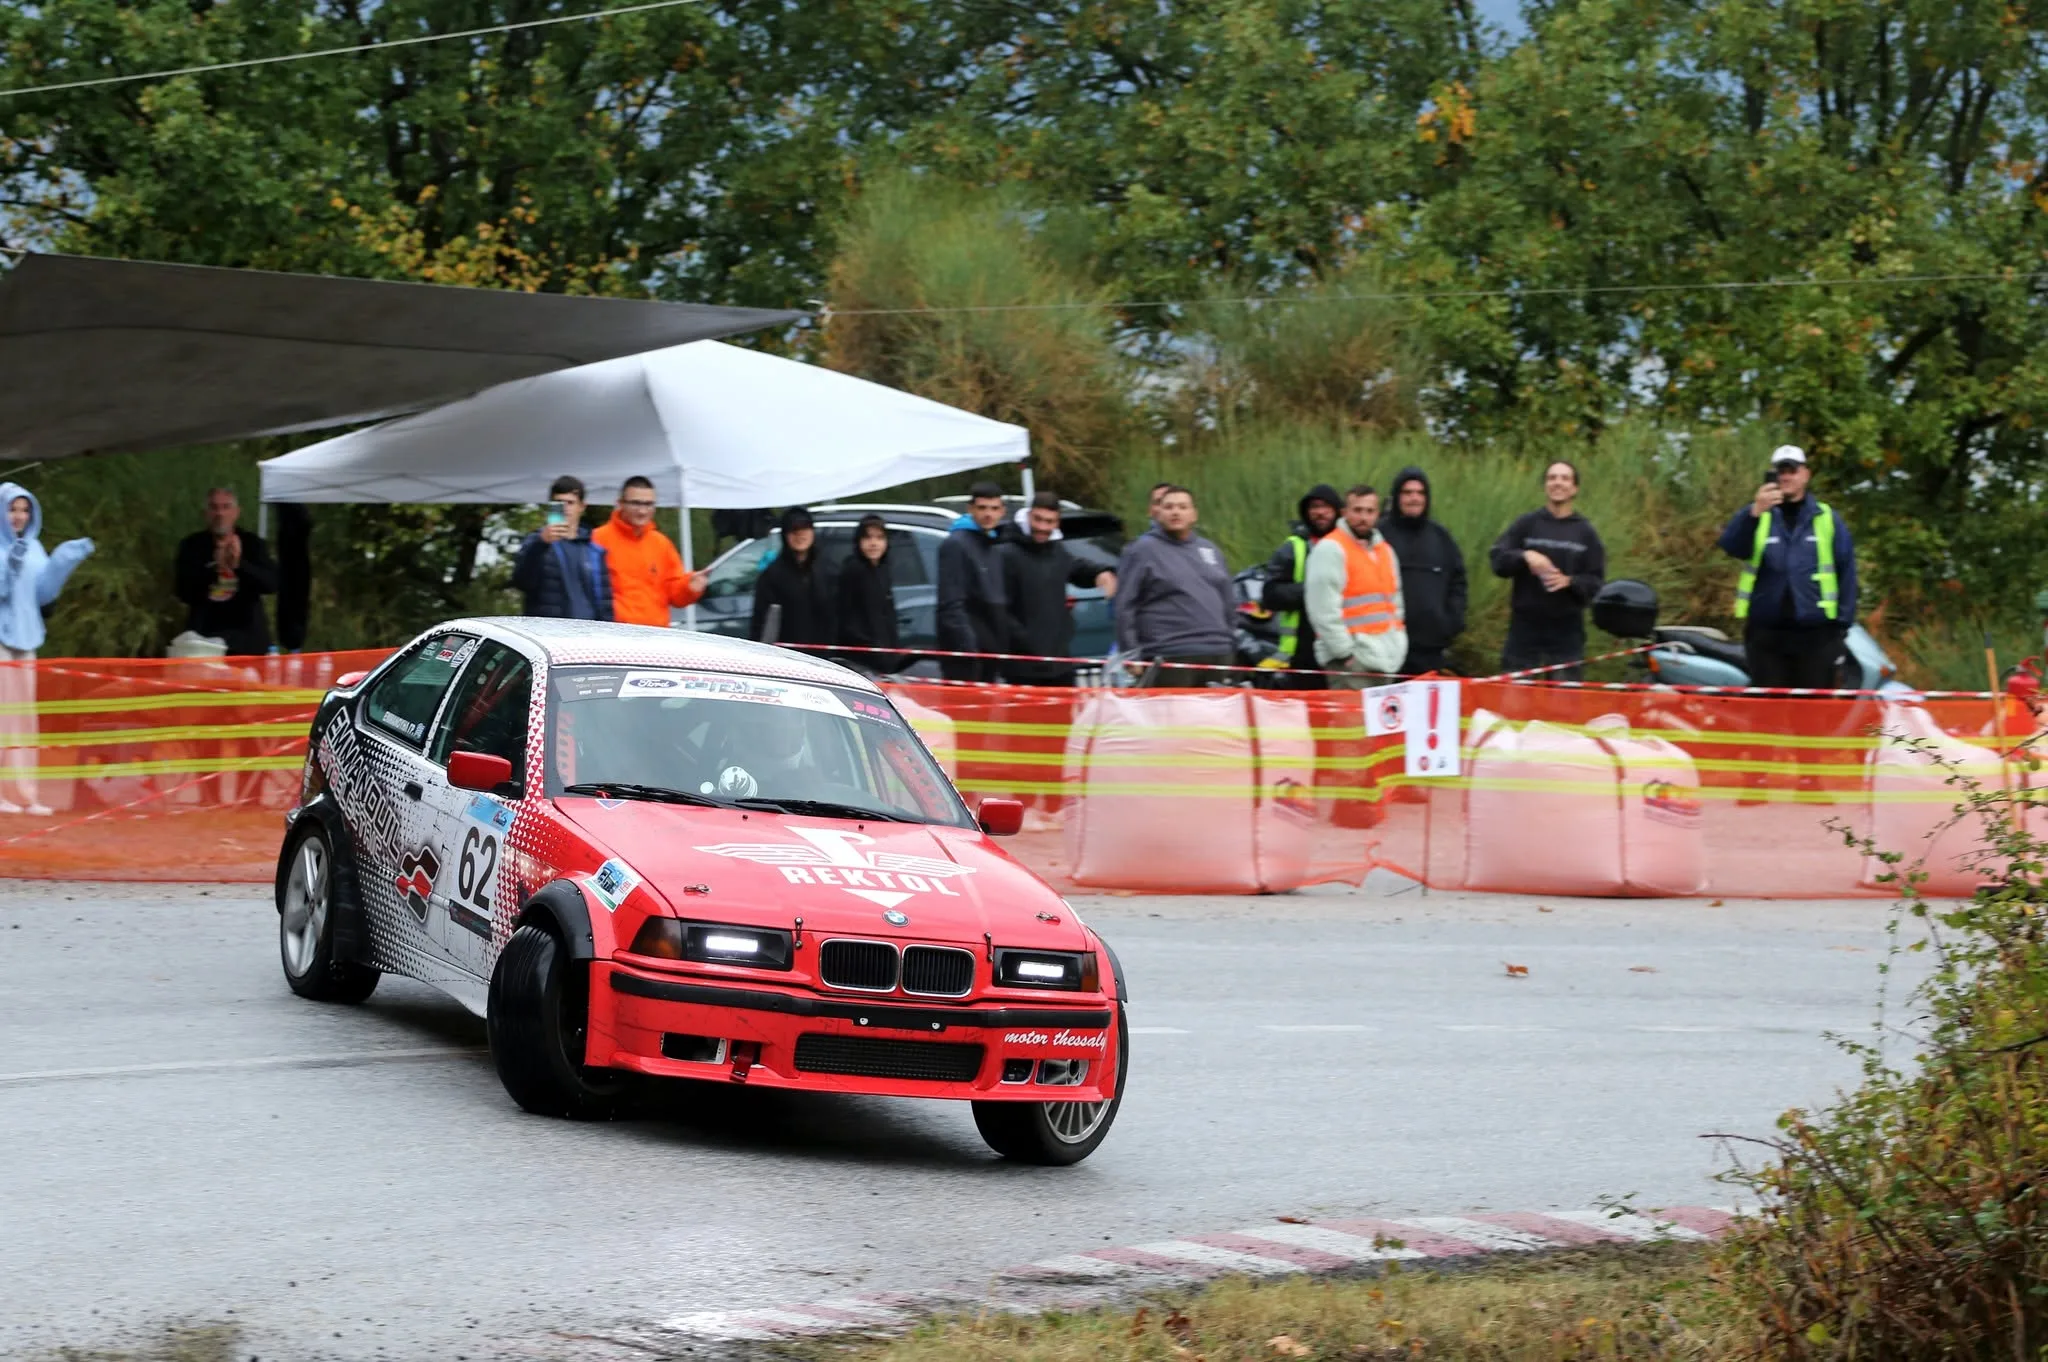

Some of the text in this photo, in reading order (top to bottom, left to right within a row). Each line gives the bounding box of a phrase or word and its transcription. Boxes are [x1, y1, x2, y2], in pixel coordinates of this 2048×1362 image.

[637, 679, 670, 688] Ford
[325, 705, 401, 864] EMMANOUIL
[458, 826, 497, 912] 62
[777, 866, 961, 896] REKTOL
[1004, 1029, 1107, 1052] motor thessaly
